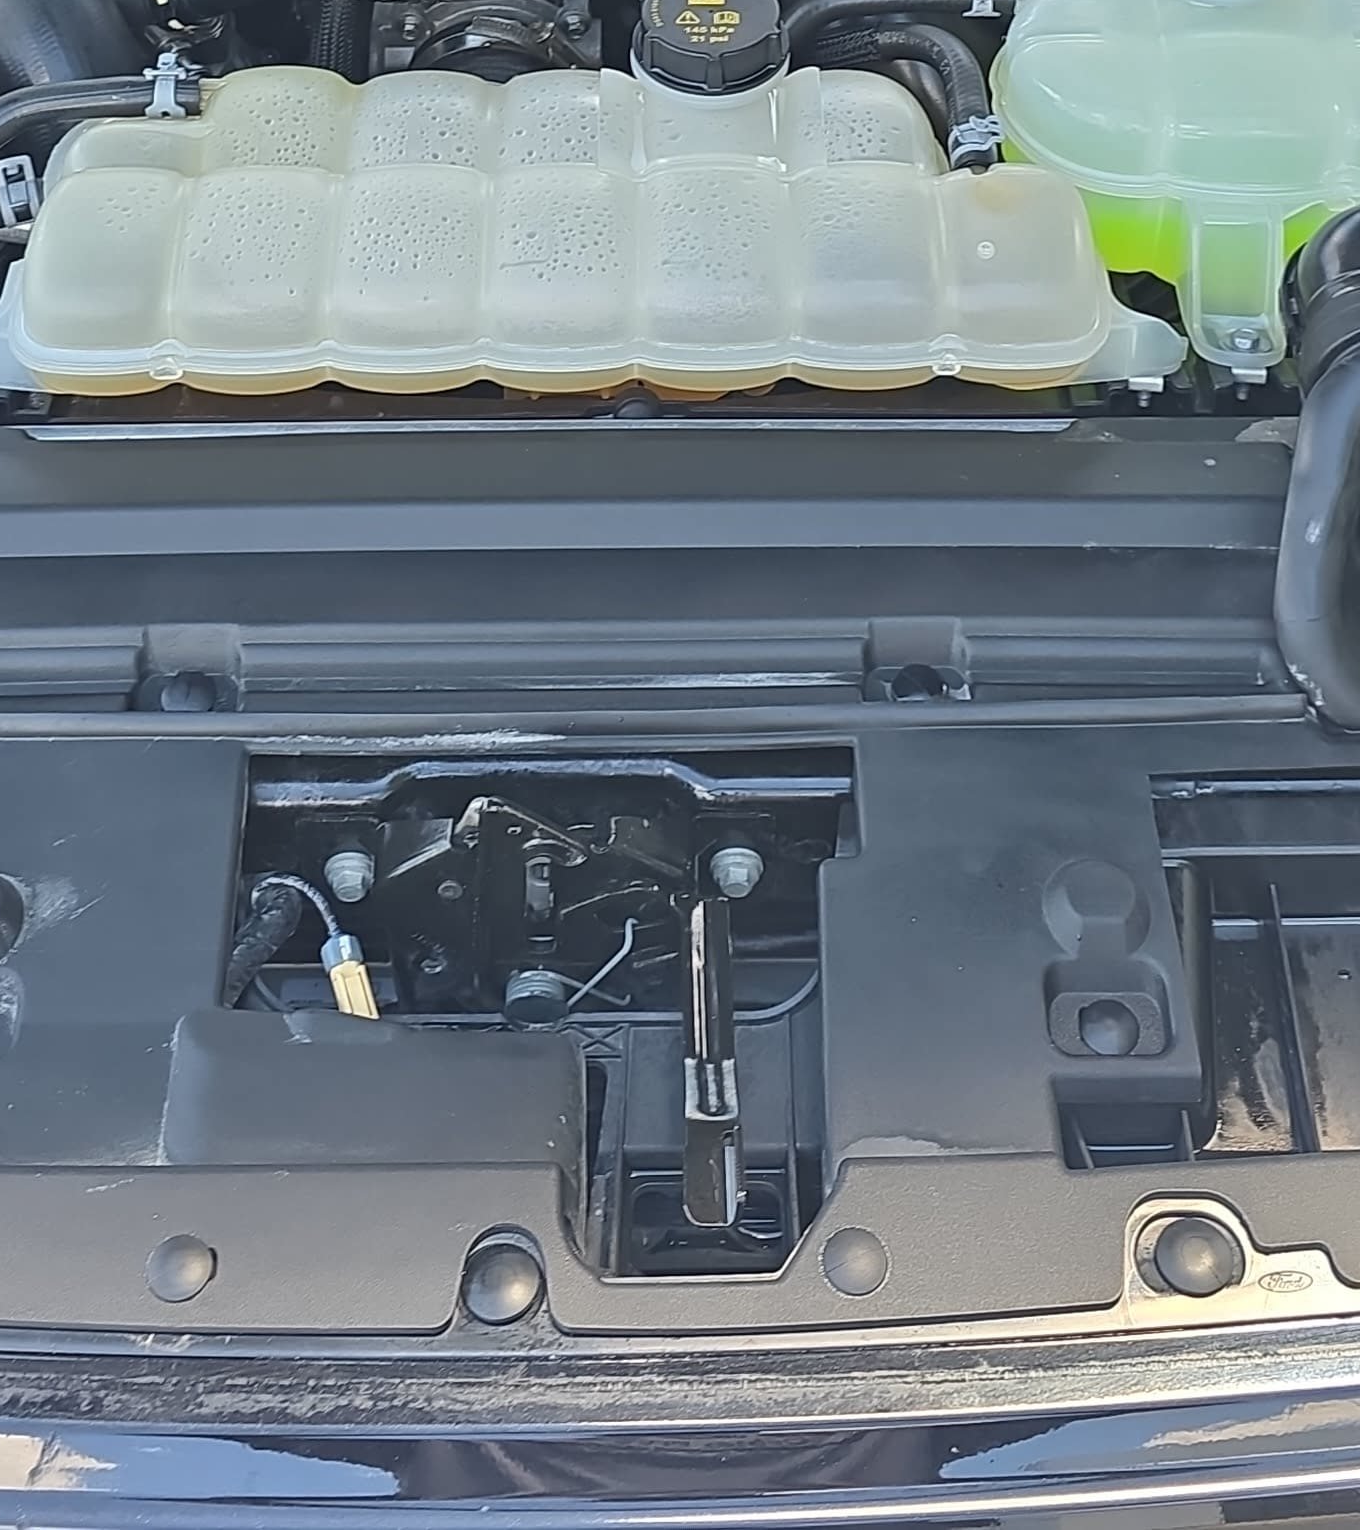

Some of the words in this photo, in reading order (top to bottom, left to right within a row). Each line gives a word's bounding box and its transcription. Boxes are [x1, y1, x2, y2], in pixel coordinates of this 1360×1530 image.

[683, 26, 709, 34] 145
[710, 26, 736, 34] kPa
[690, 35, 707, 43] 21
[709, 35, 730, 44] psi
